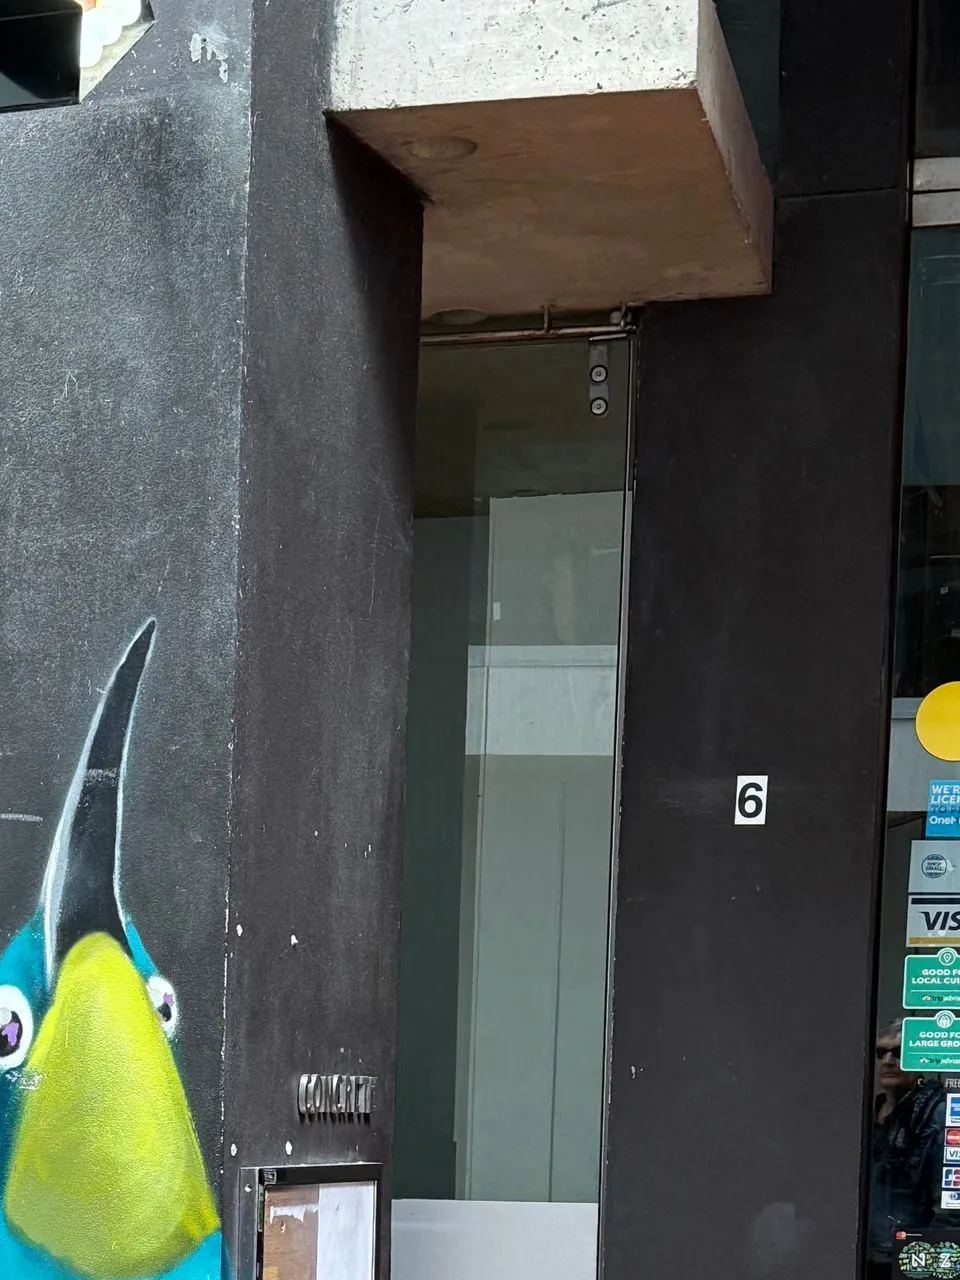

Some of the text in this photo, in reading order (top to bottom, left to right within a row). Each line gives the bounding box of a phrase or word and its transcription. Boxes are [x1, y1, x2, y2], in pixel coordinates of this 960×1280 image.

[738, 782, 763, 818] 6
[922, 968, 951, 976] GOOD
[911, 977, 943, 985] LOCAL
[919, 1031, 948, 1039] GOOD
